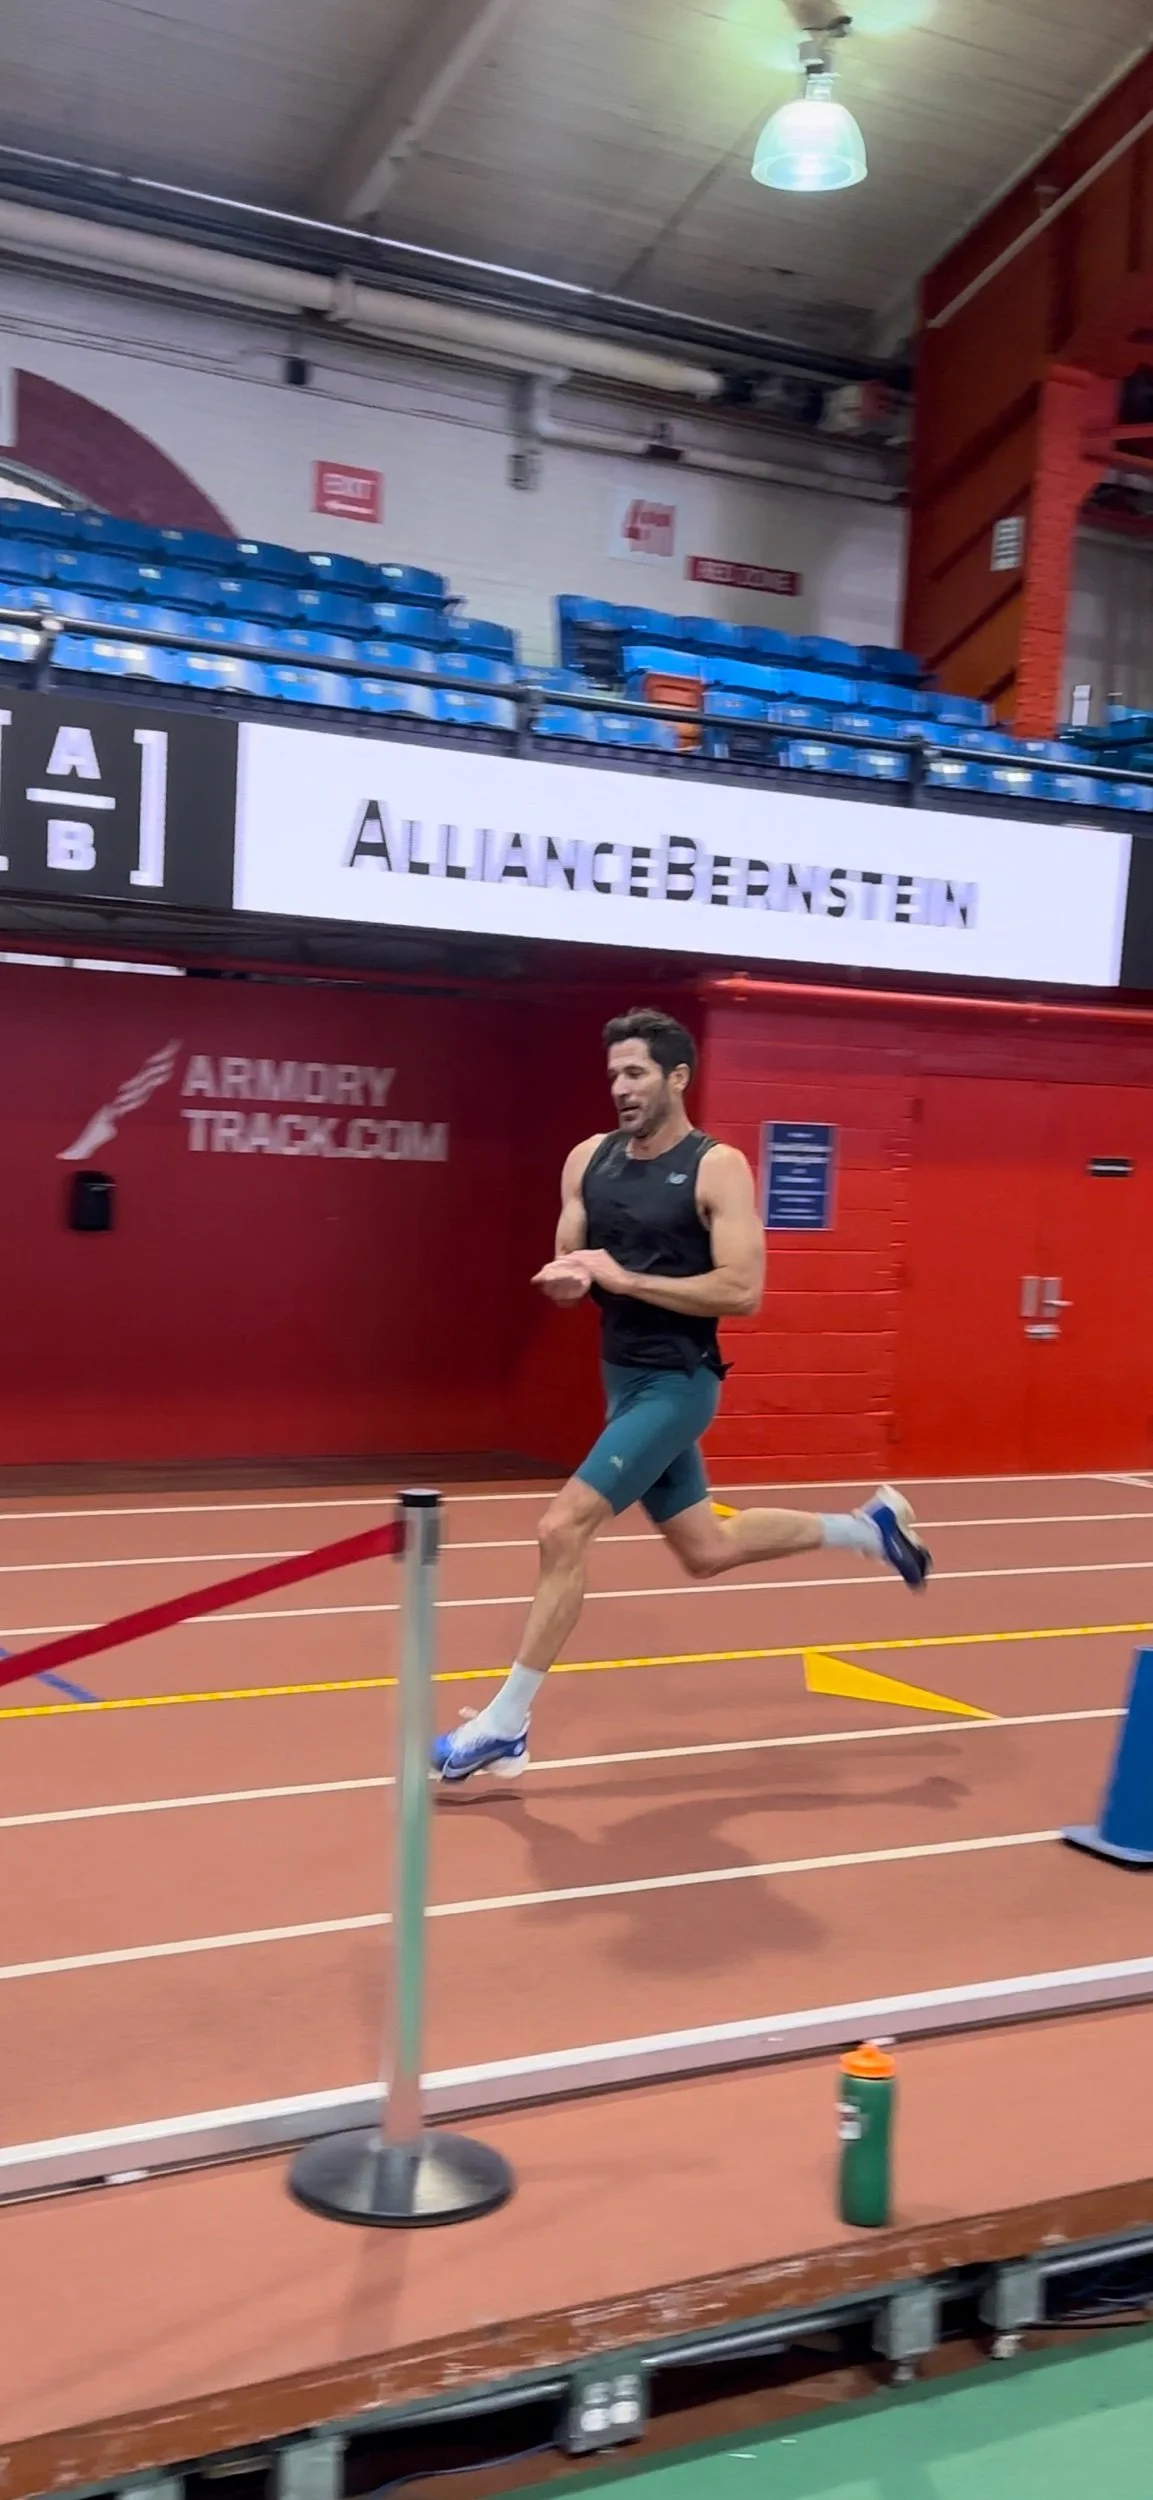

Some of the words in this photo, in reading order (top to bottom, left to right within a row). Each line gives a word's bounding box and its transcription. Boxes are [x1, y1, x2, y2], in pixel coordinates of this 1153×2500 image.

[323, 472, 376, 500] EXIT
[46, 726, 101, 779] A
[47, 819, 96, 871] B
[345, 798, 978, 929] ALLIANCEBERNSTEIN
[180, 1054, 396, 1107] ARMORY
[180, 1109, 448, 1161] TRACK.COM
